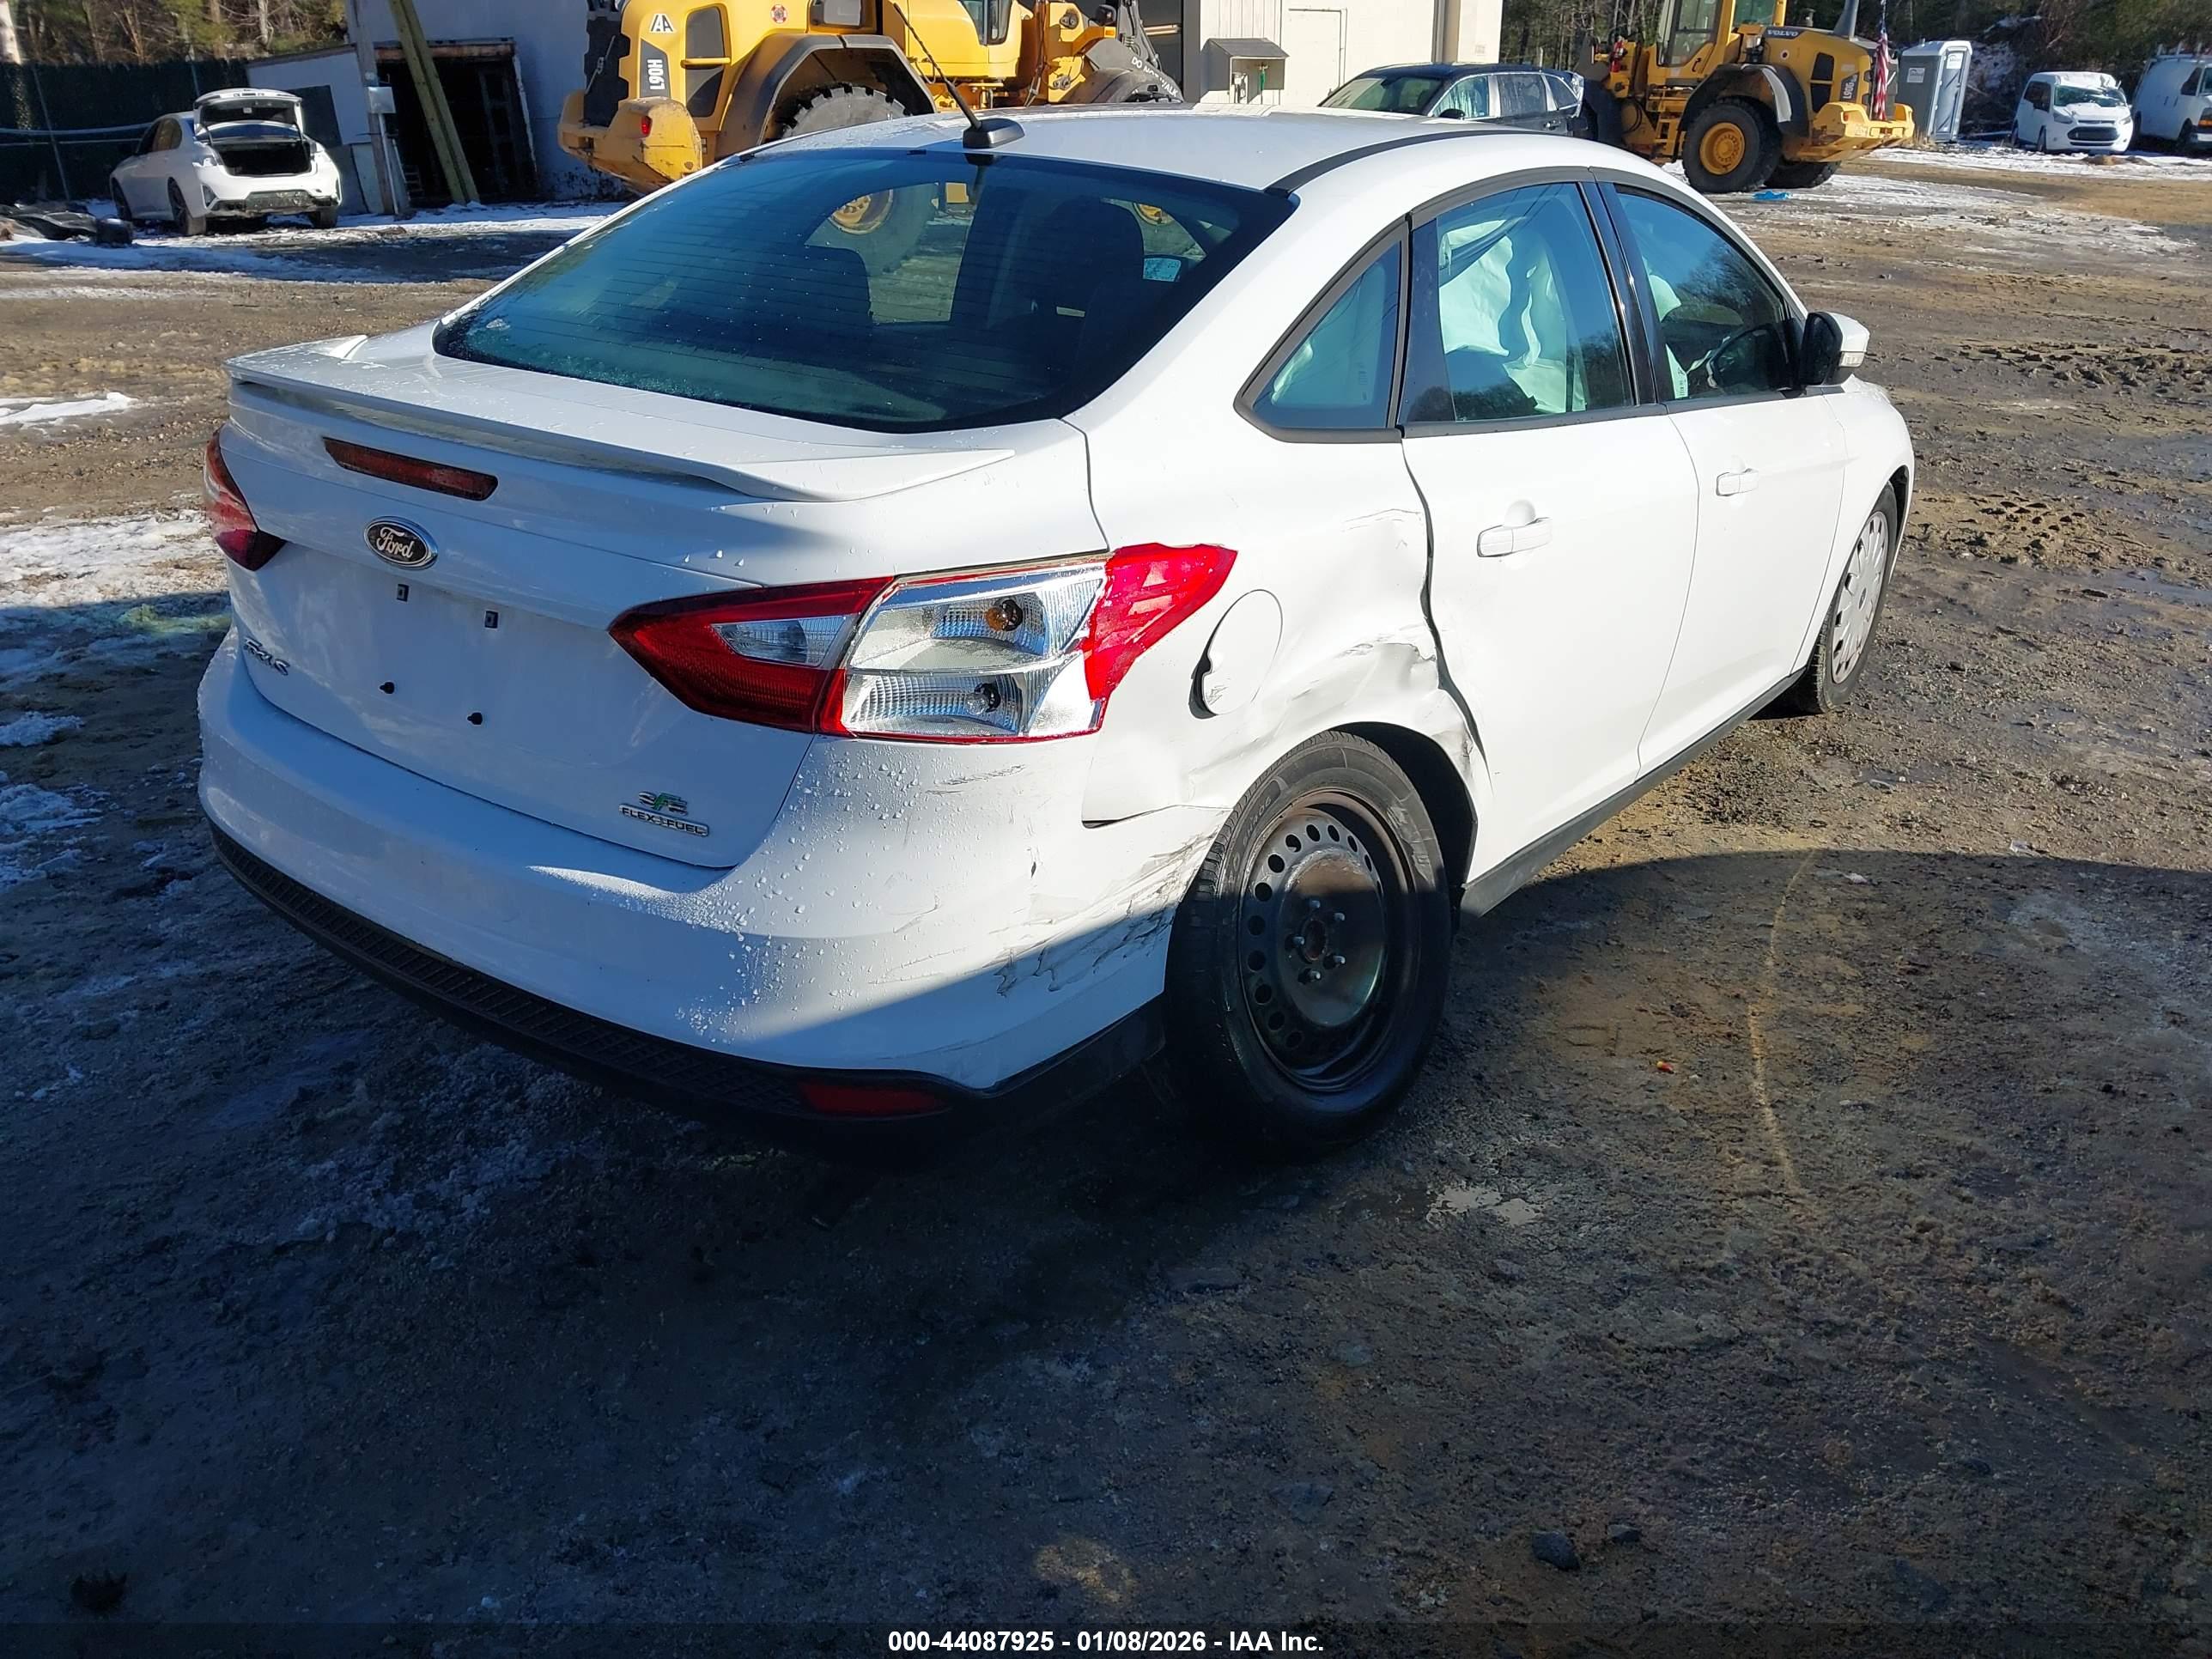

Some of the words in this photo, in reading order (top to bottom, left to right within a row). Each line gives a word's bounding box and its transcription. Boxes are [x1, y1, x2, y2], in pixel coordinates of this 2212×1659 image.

[647, 58, 665, 90] L90H
[1131, 56, 1143, 69] DO
[376, 526, 416, 559] Ford
